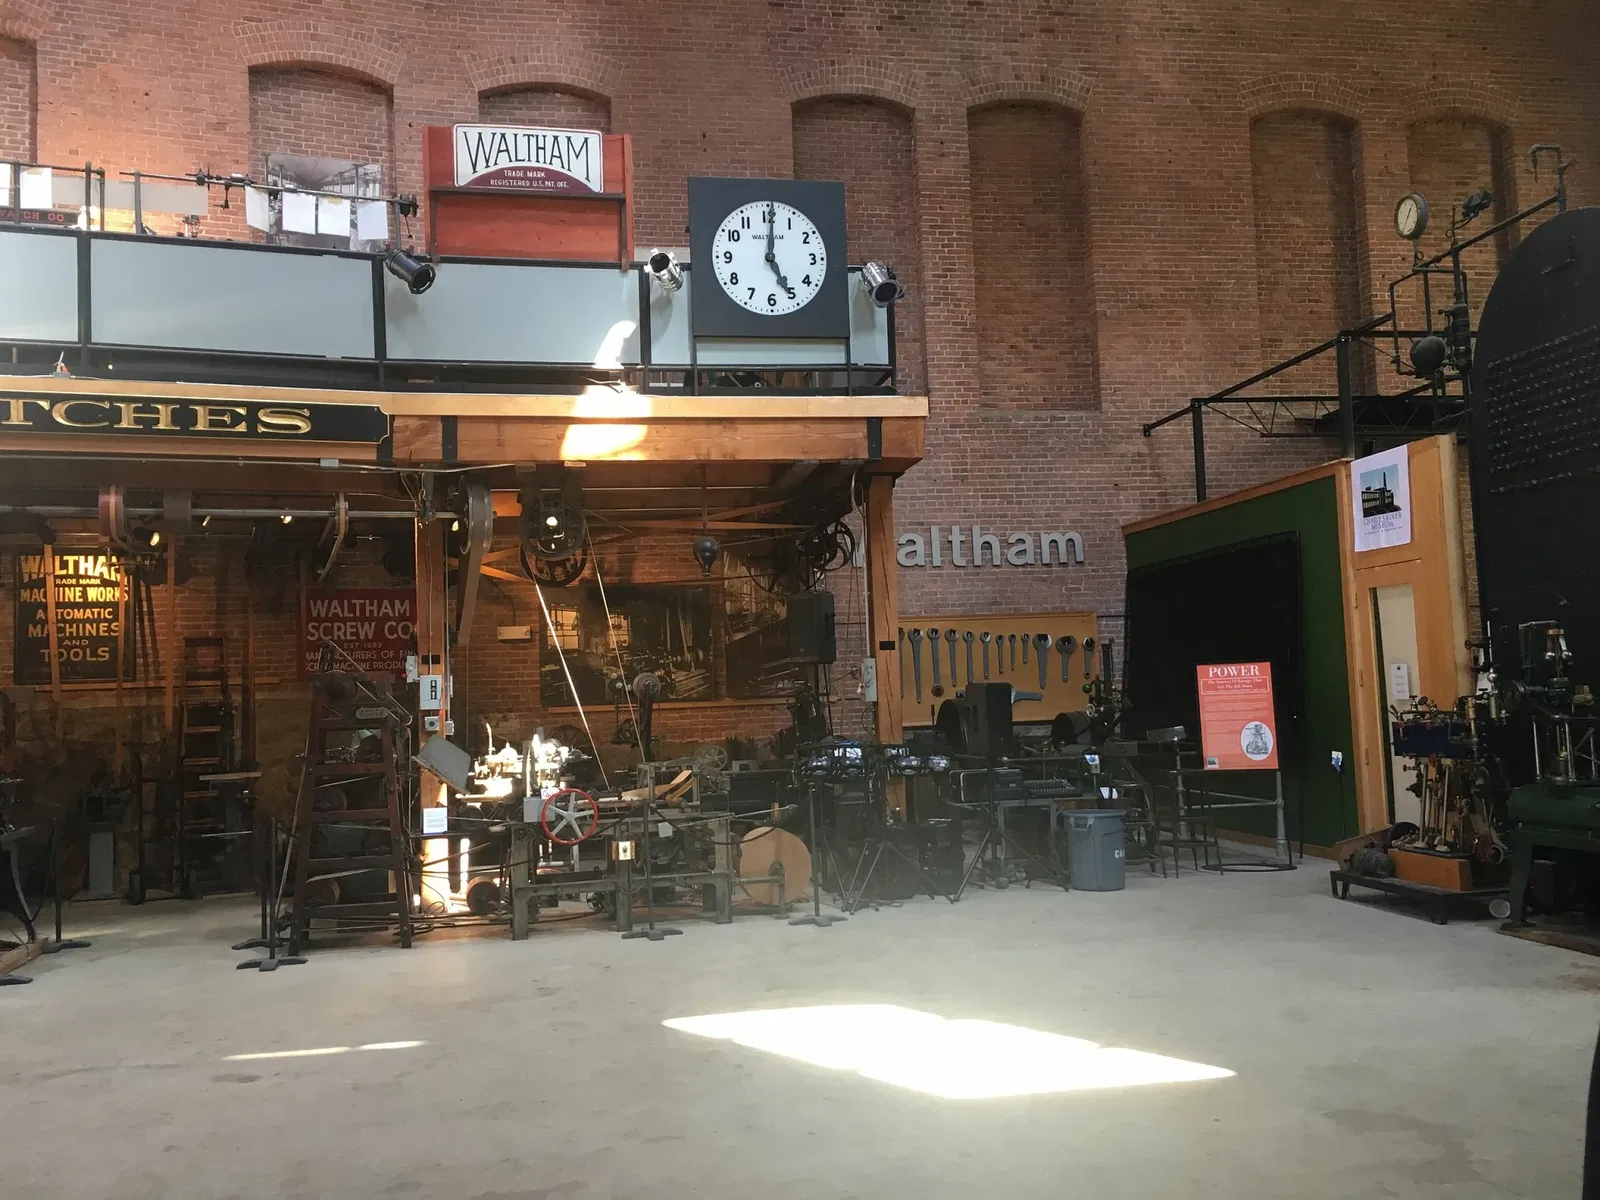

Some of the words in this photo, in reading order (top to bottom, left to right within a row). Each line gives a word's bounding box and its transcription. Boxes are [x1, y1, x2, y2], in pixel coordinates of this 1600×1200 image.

[463, 131, 591, 183] WALTHAM
[503, 169, 524, 178] TRADE
[527, 170, 546, 178] MARK
[490, 178, 530, 187] REGISTERED
[0, 209, 40, 220] ACH
[741, 216, 751, 229] 11
[788, 217, 791, 230] 1
[728, 229, 740, 242] 10
[802, 232, 810, 244] 2
[724, 251, 732, 264] 9
[809, 253, 816, 265] 3
[730, 272, 738, 285] 8
[802, 274, 812, 287] 4
[747, 287, 756, 300] 7
[767, 293, 776, 306] 6
[787, 287, 796, 300] 5
[0, 399, 312, 434] TCHES
[36, 608, 113, 620] ATOMATIC
[309, 599, 410, 618] WALTHAM
[306, 621, 376, 641] SCREW
[381, 649, 395, 659] OF
[333, 661, 371, 671] MACNE
[373, 660, 405, 670] PRODU
[1208, 665, 1260, 678] POWER
